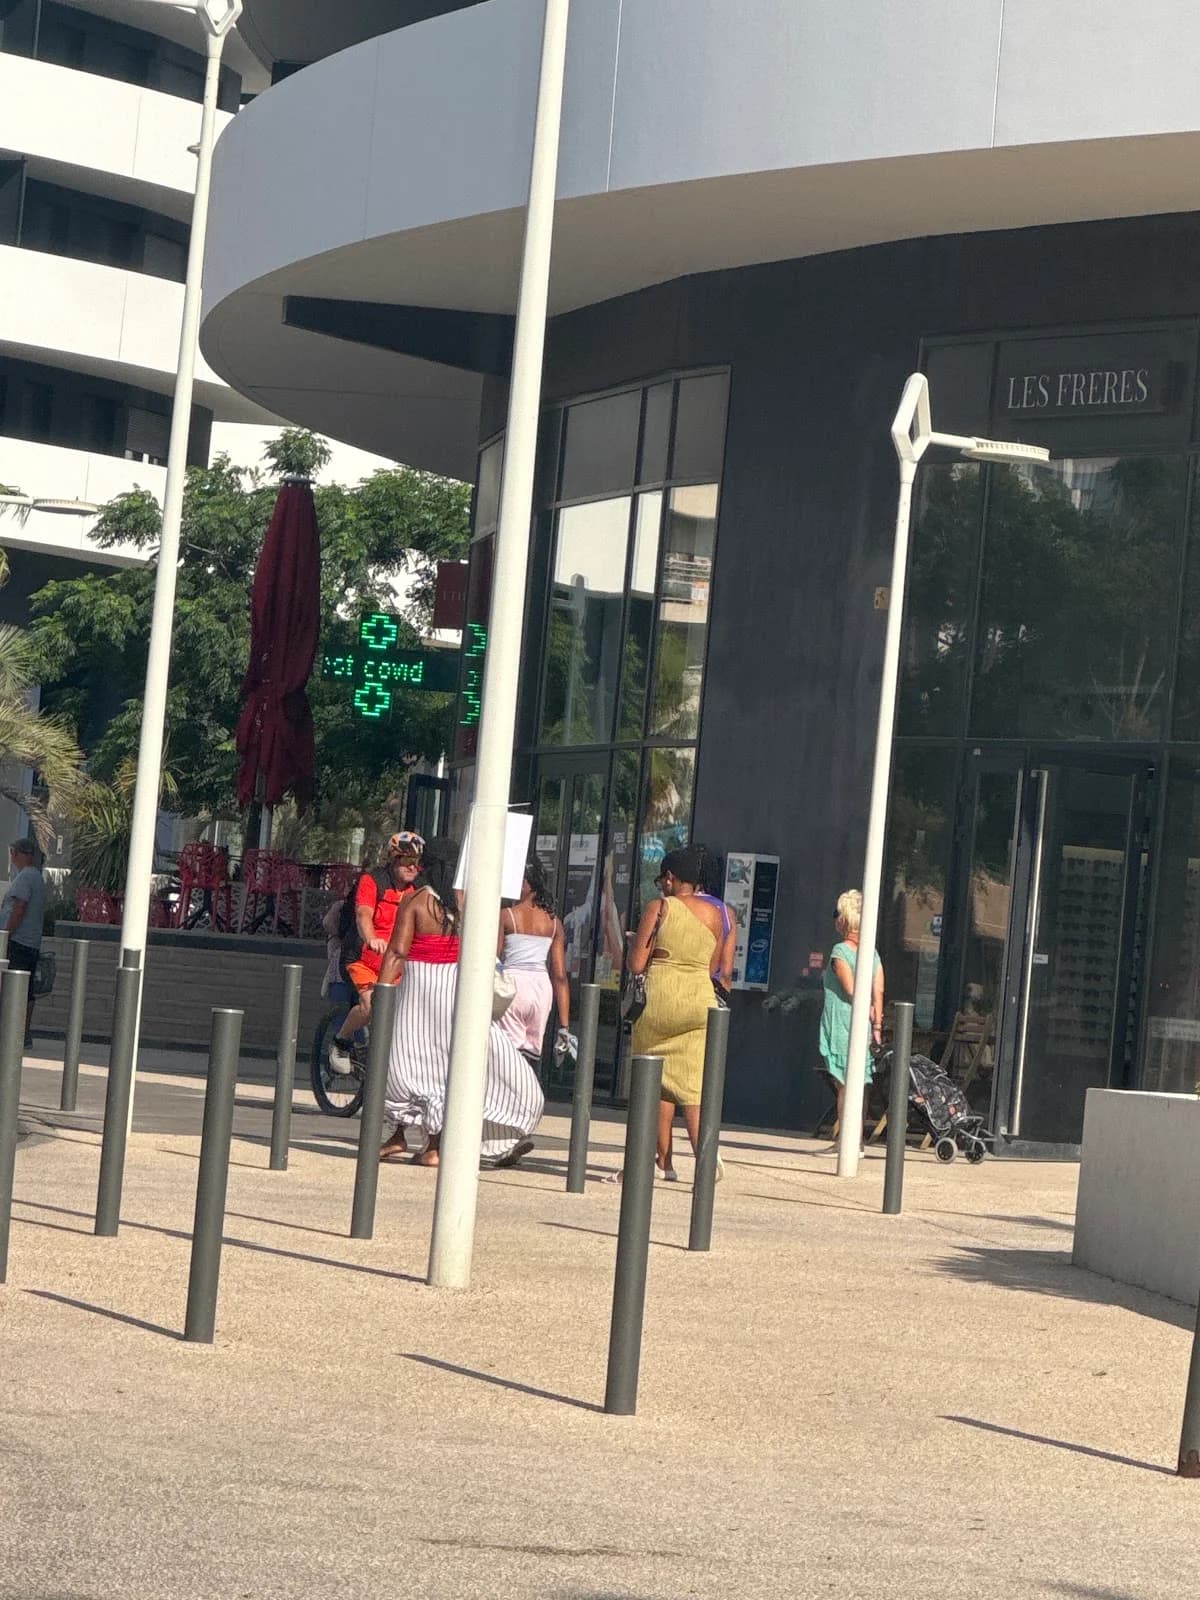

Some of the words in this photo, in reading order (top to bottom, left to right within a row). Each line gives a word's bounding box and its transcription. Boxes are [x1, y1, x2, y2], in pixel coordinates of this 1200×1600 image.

[1008, 375, 1050, 409] LES
[1056, 368, 1150, 407] FRERES
[364, 661, 423, 682] covid
